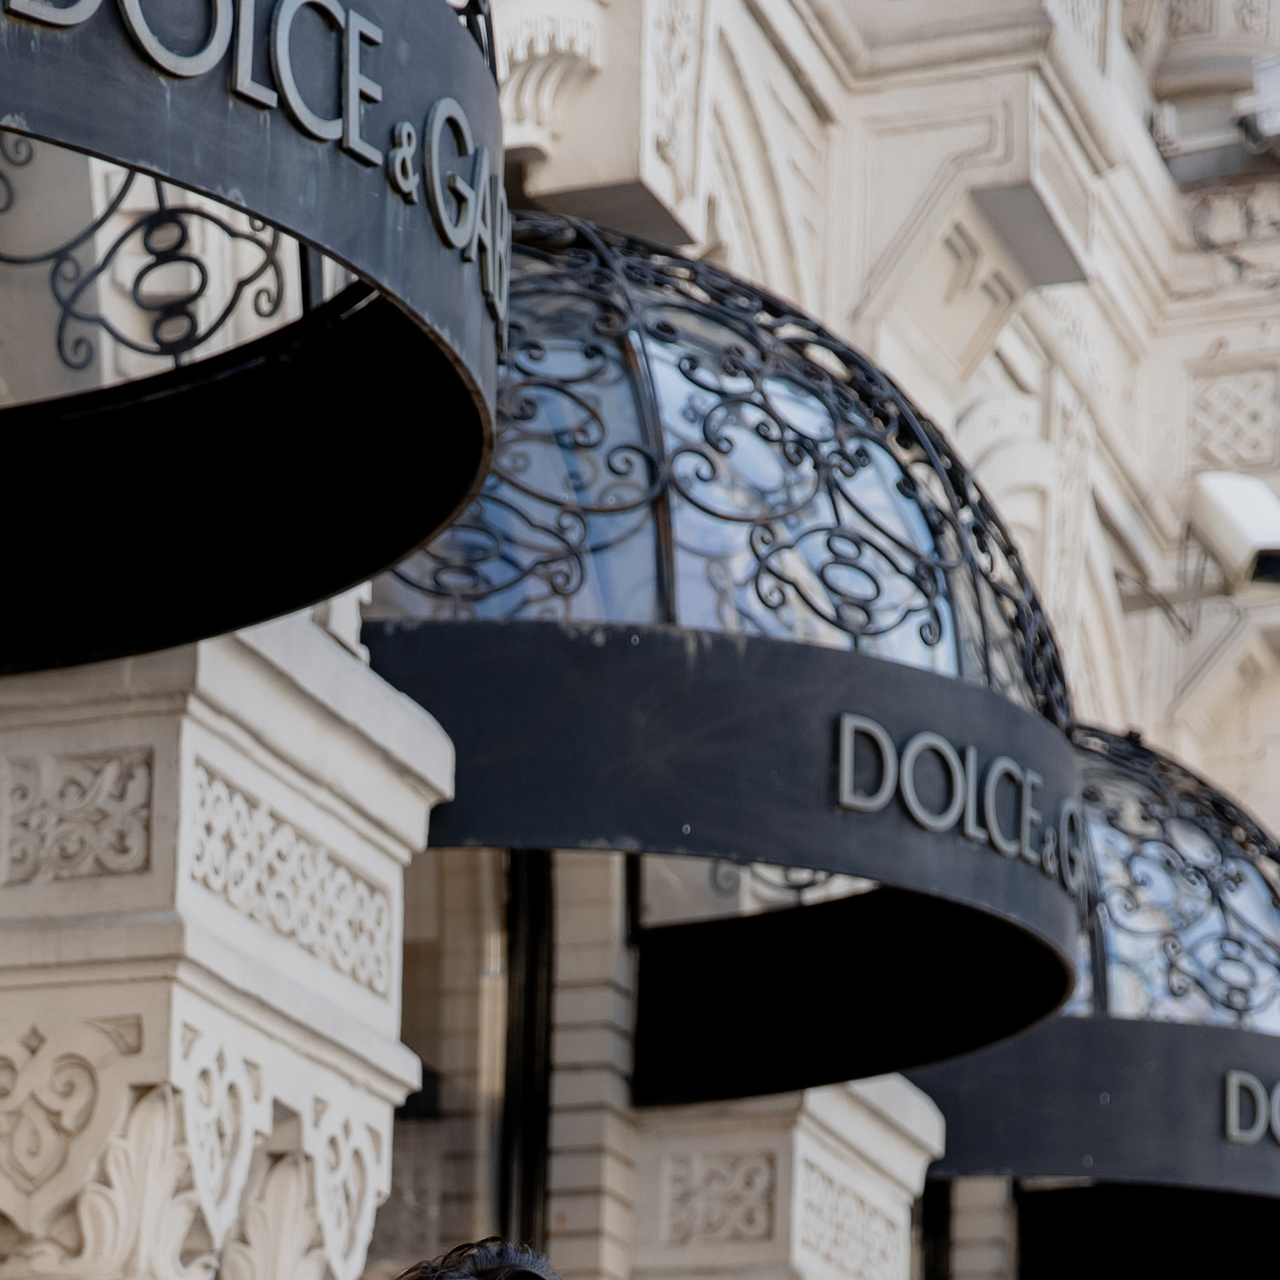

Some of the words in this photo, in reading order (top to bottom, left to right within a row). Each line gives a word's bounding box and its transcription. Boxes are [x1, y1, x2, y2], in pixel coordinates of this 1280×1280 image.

[4, 0, 383, 167] OLCE
[388, 121, 421, 204] &
[423, 96, 510, 350] GAB
[840, 711, 1043, 865] DOLCE
[1042, 826, 1059, 878] &
